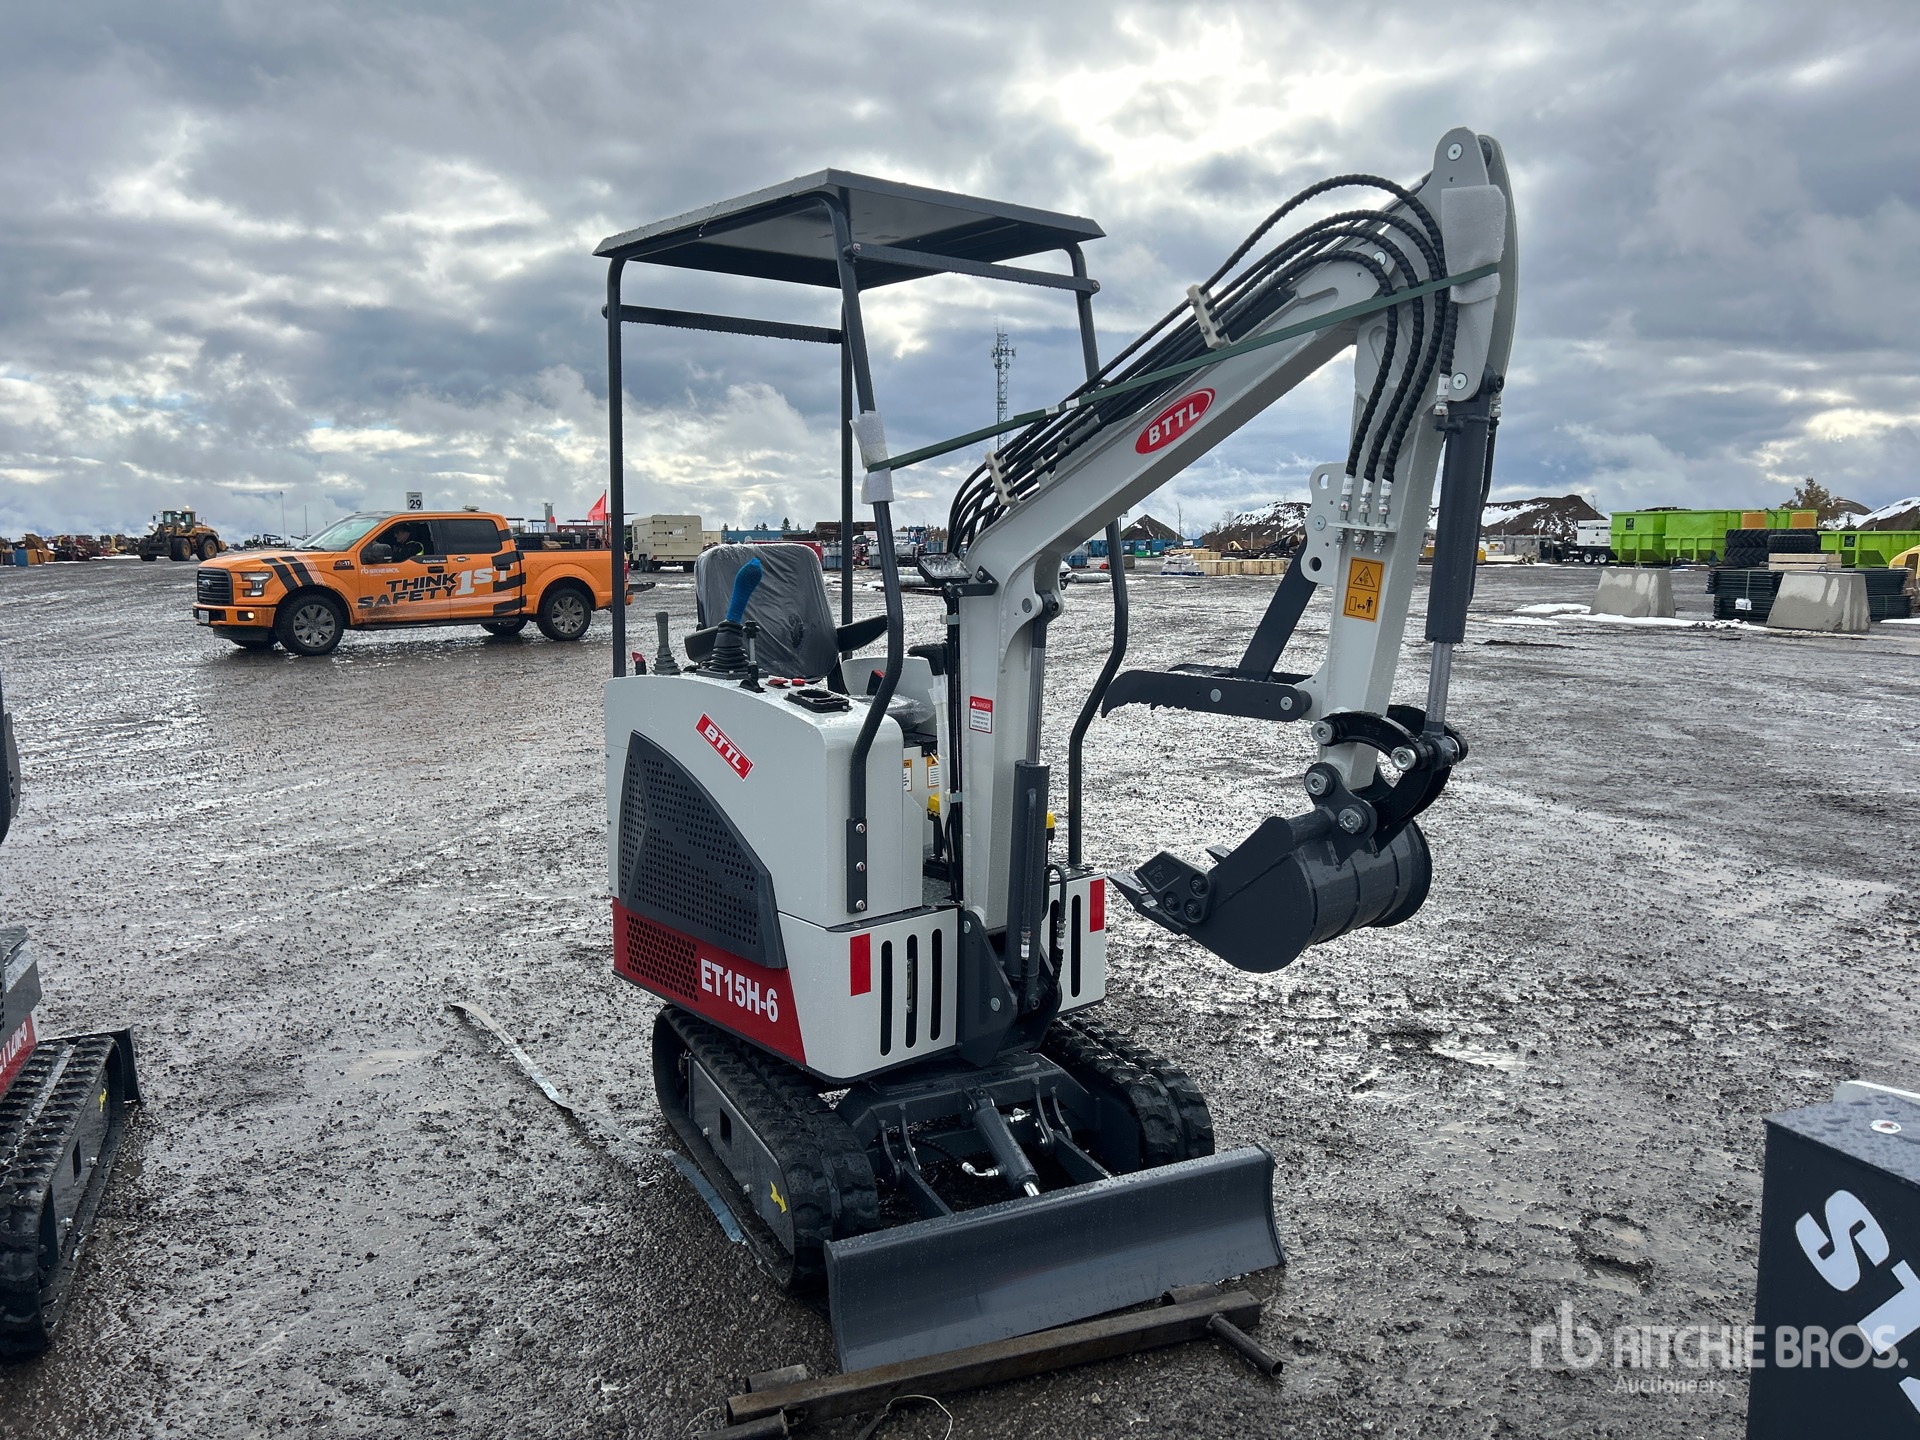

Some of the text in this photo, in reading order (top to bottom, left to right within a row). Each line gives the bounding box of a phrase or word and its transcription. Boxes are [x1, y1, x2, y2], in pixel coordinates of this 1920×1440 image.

[1149, 402, 1199, 446] BTTL
[410, 499, 422, 509] 29
[386, 572, 458, 593] THINK
[455, 564, 513, 596] 1ST
[358, 585, 457, 609] SAFETY
[703, 723, 742, 770] BTTL
[700, 958, 779, 1023] ET15H-6
